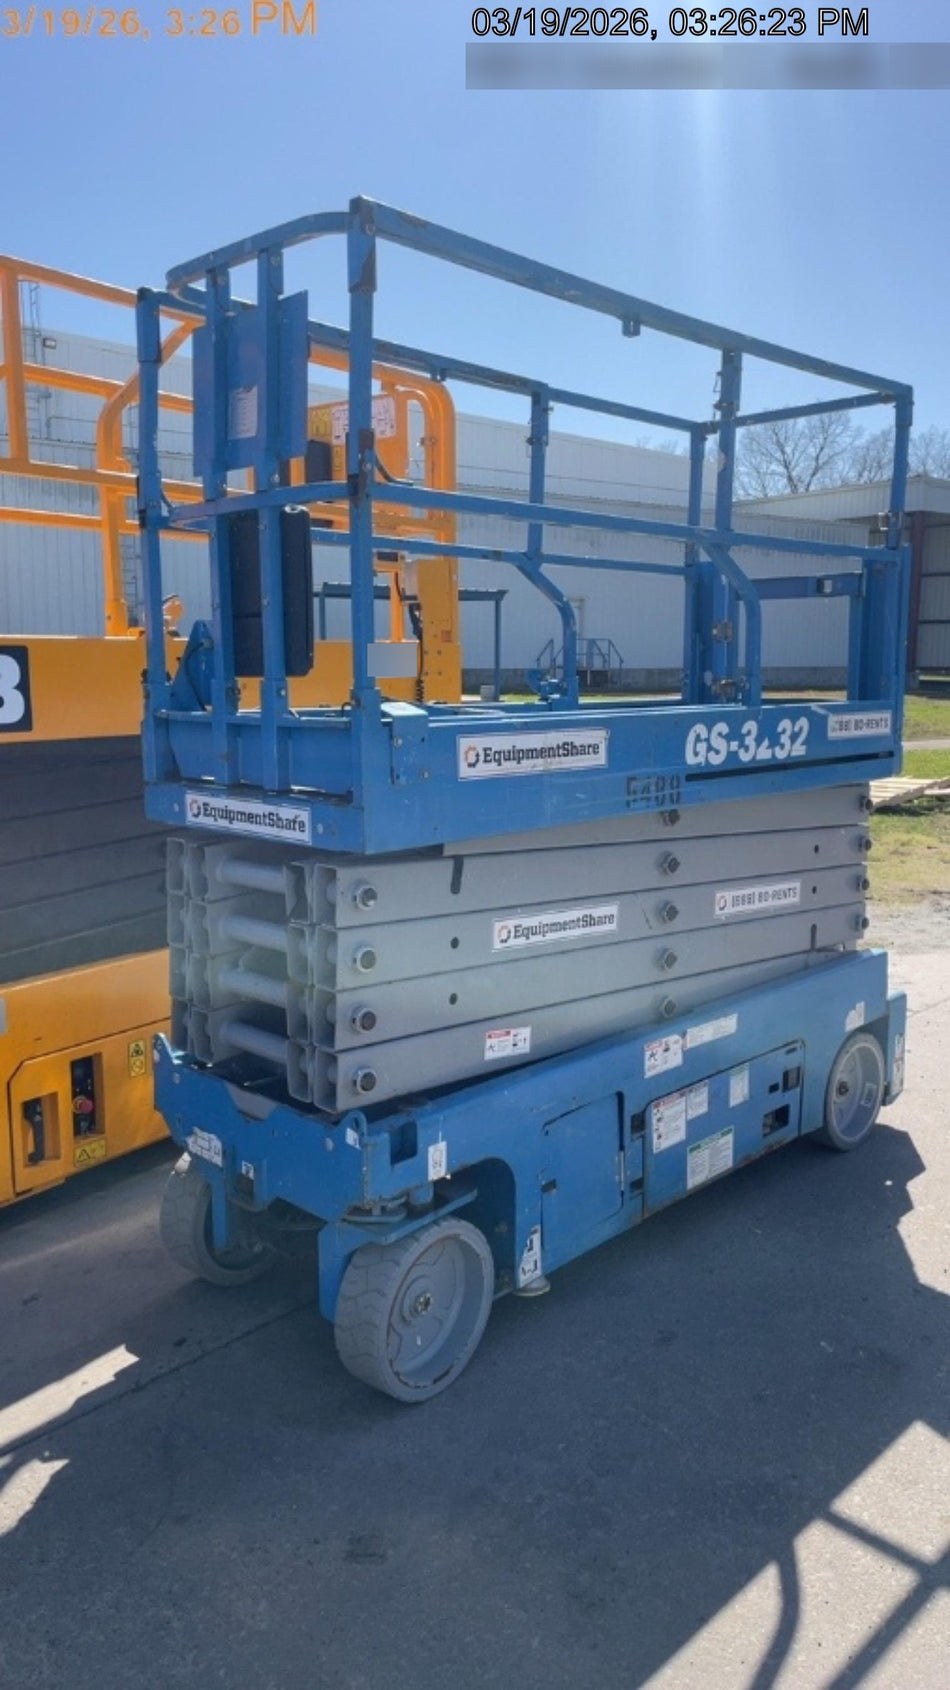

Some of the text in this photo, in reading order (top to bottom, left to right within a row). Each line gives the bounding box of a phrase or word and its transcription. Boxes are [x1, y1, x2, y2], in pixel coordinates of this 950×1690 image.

[482, 741, 600, 766] EquipmentShare
[202, 803, 306, 833] EquipmentShare
[513, 913, 615, 940] EquipmentShare
